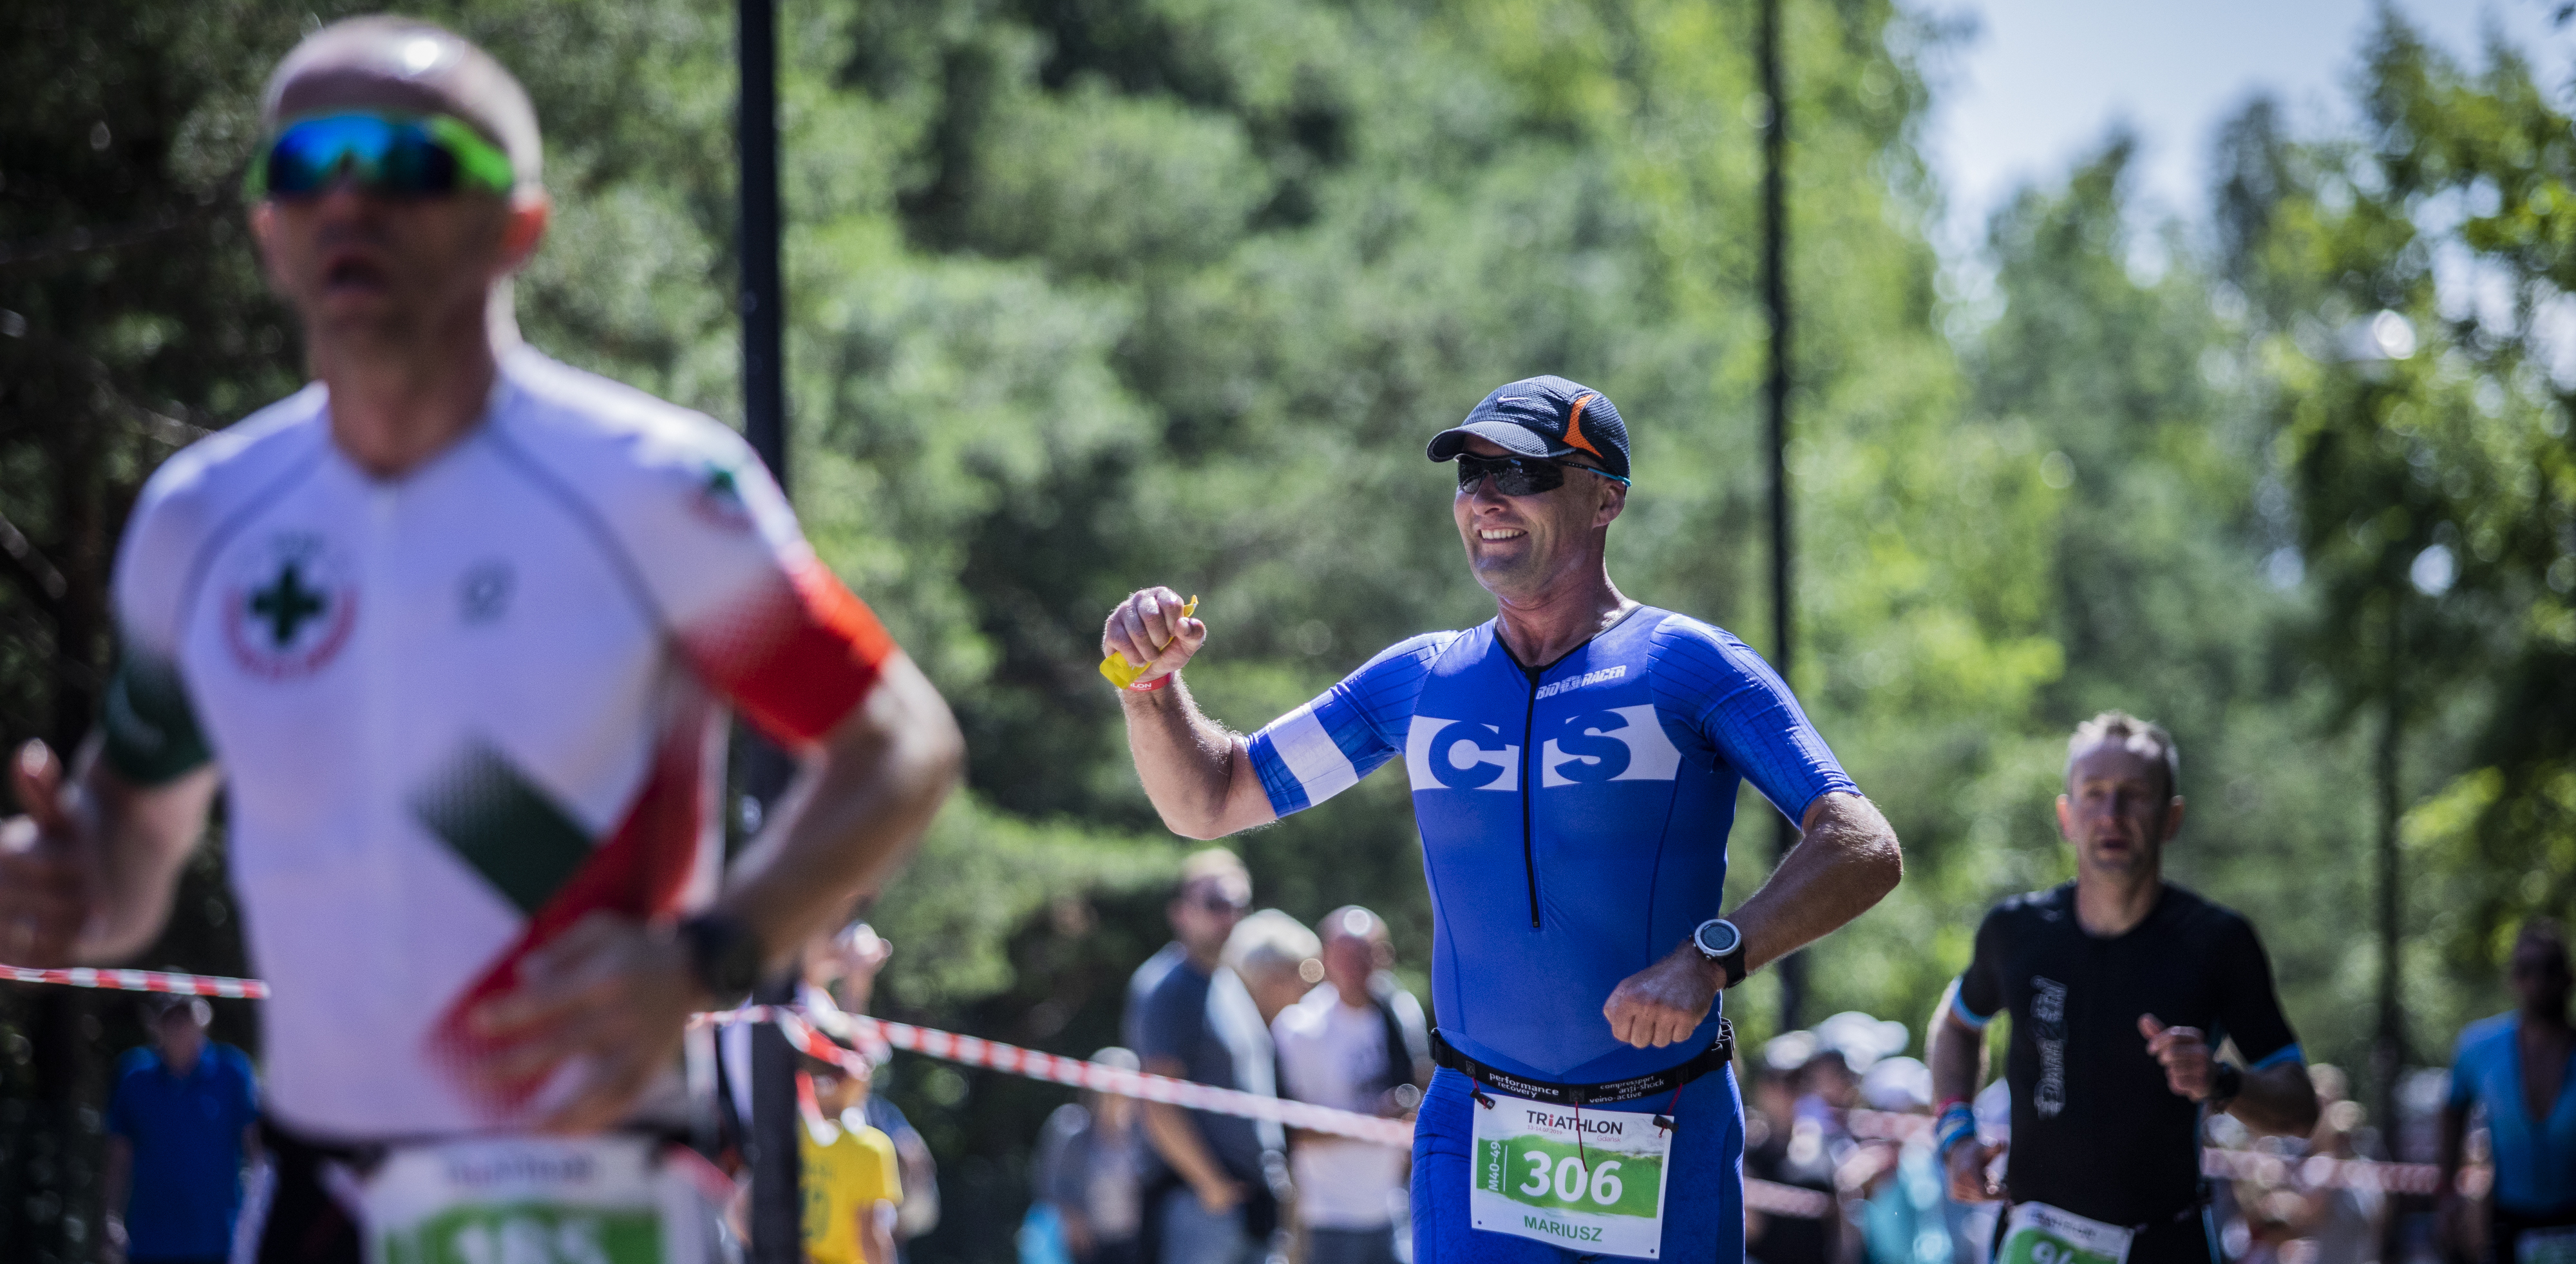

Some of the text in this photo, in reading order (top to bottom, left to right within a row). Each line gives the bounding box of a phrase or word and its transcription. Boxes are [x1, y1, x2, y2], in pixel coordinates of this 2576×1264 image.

[1489, 1073, 1559, 1096] performance
[1498, 1082, 1537, 1098] recovery
[1600, 1075, 1654, 1089] compressport
[1618, 1078, 1665, 1094] anti-shock
[1589, 1091, 1642, 1104] veino-active
[1527, 1125, 1563, 1135] 13-14.07.2019
[1596, 1135, 1622, 1143] Gdańsk
[1488, 1141, 1501, 1192] M40-49
[1519, 1150, 1623, 1205] 306
[1524, 1214, 1603, 1242] MARIUSZ
